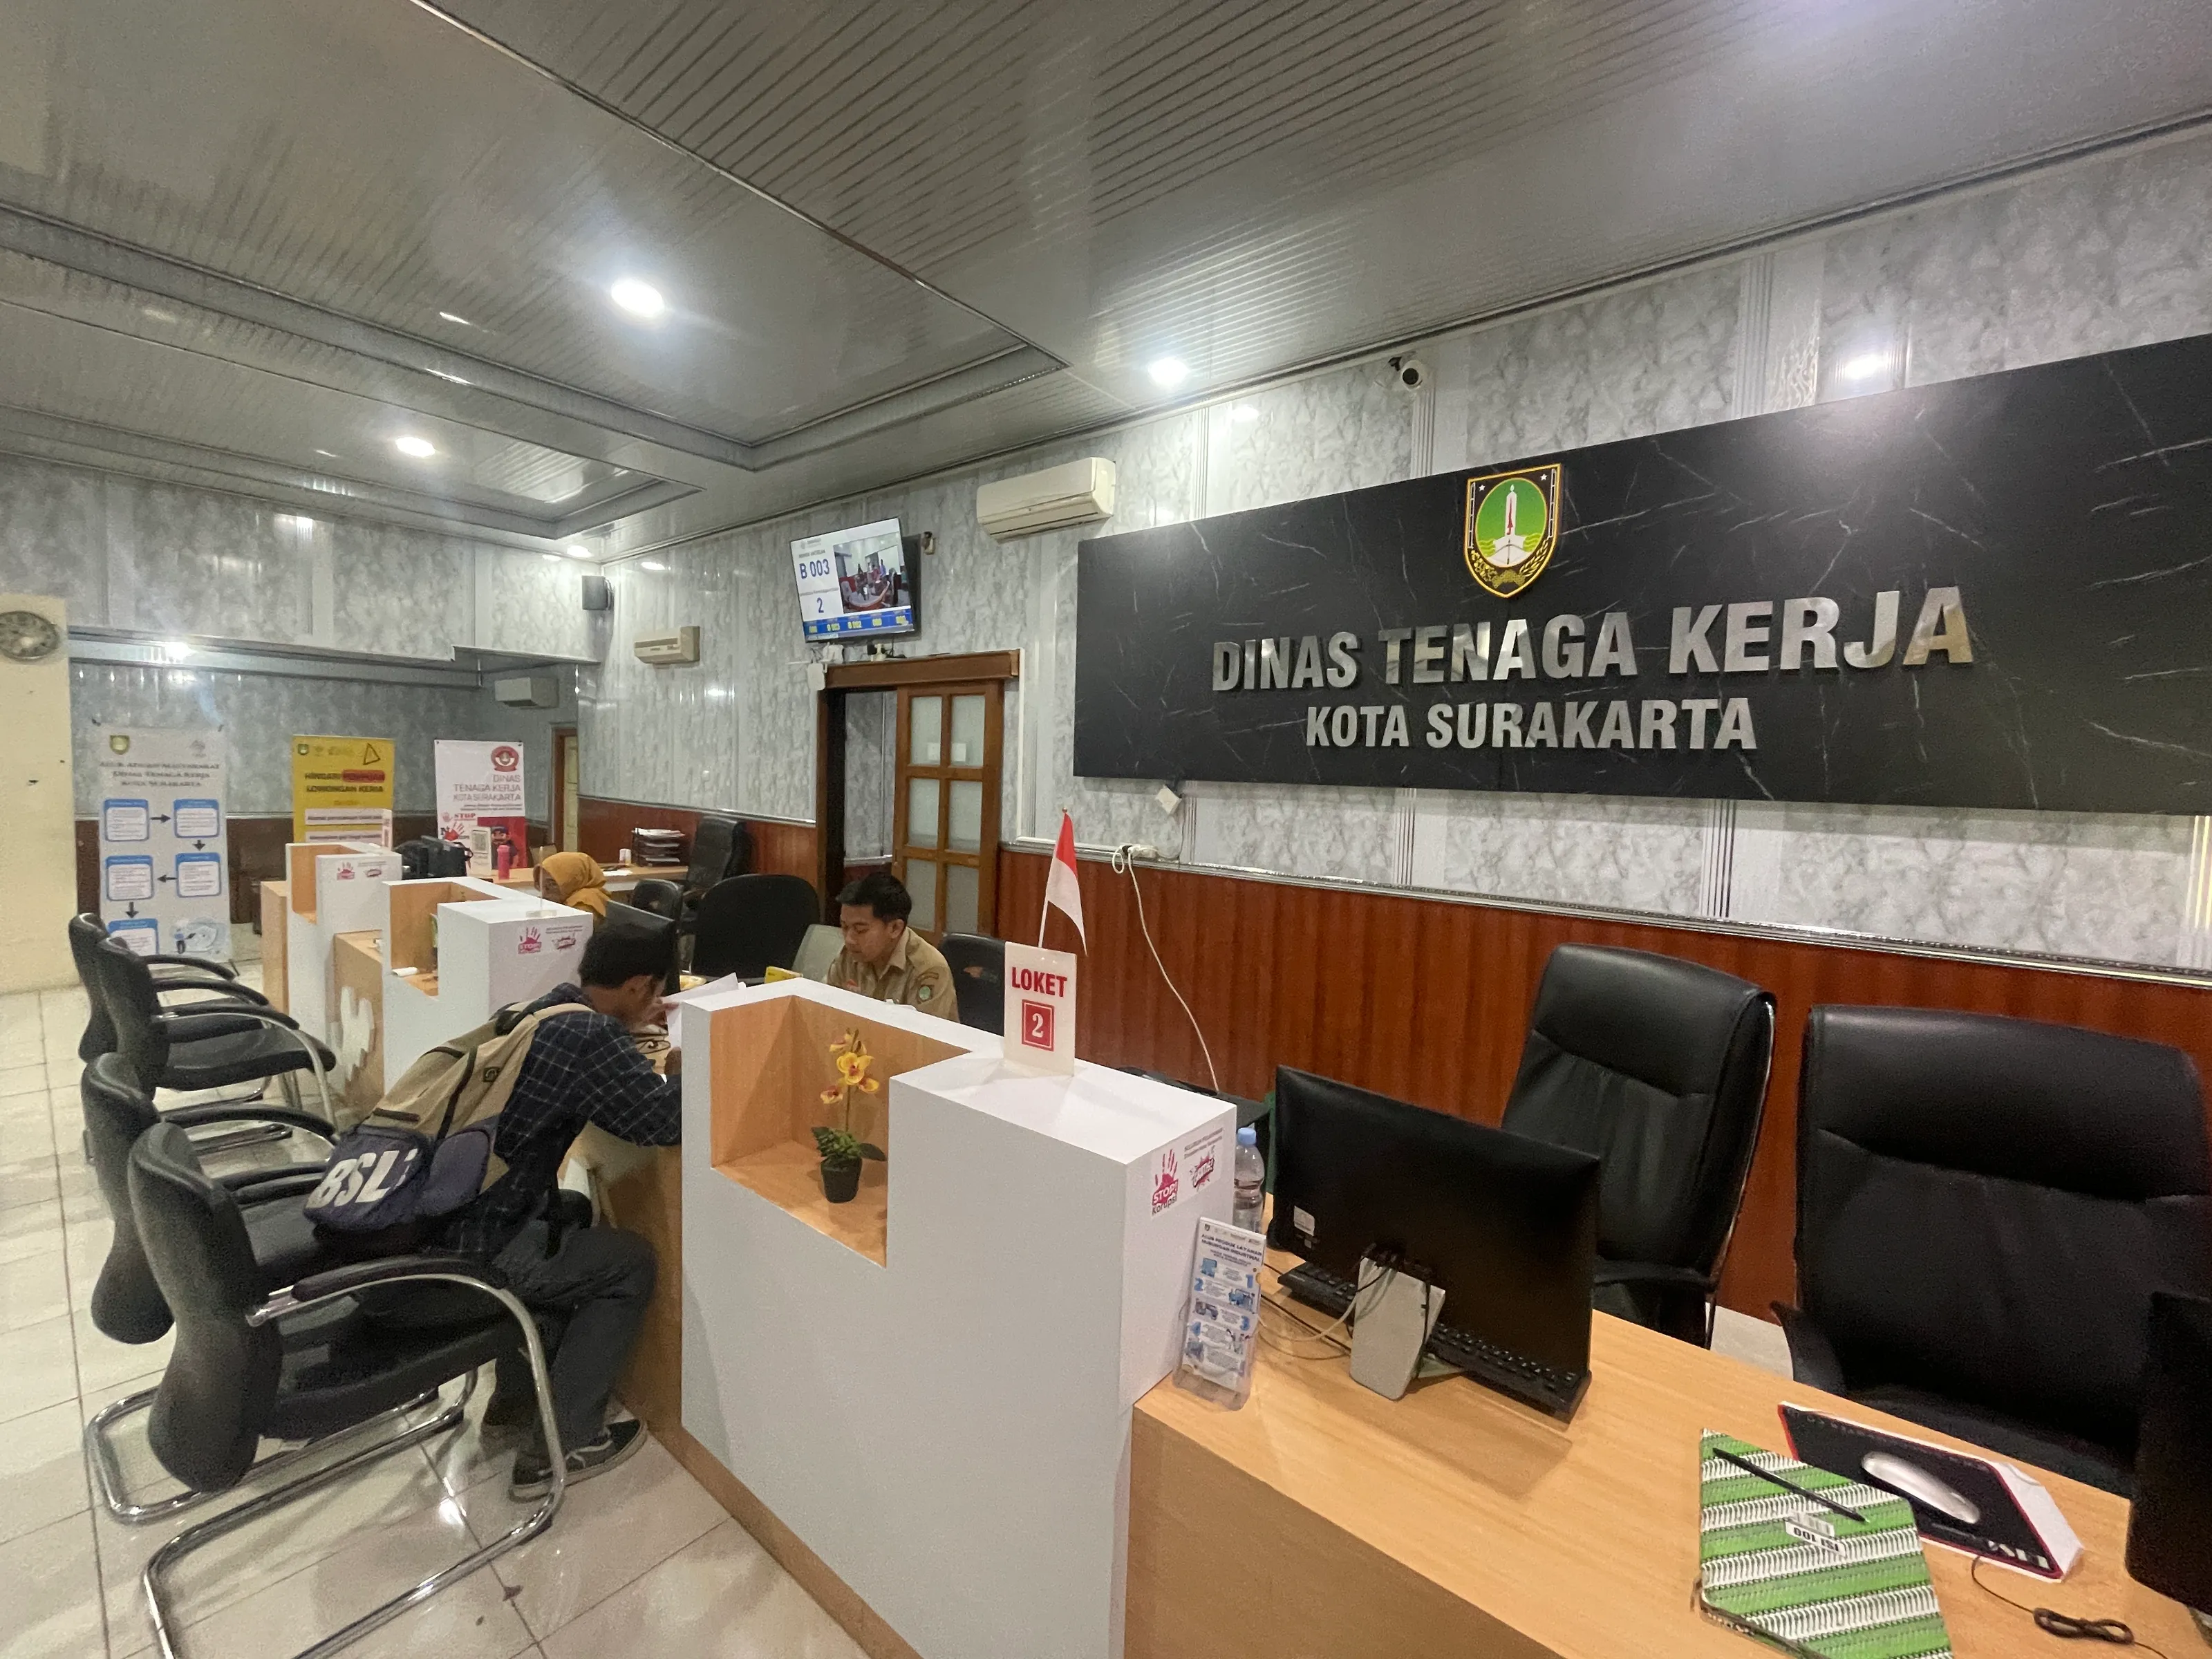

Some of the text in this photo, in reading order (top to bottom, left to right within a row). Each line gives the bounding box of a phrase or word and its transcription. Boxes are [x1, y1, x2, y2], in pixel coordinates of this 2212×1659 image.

[799, 559, 830, 579] B 003
[816, 597, 824, 613] 2
[1212, 585, 1974, 691] DINAS TENAGA KERJA
[1306, 697, 1758, 749] KOTA SURAKARTA
[453, 783, 490, 791] TENAGA
[493, 774, 521, 782] DINAS
[1011, 966, 1067, 997] LOKET
[1031, 1013, 1044, 1038] 2
